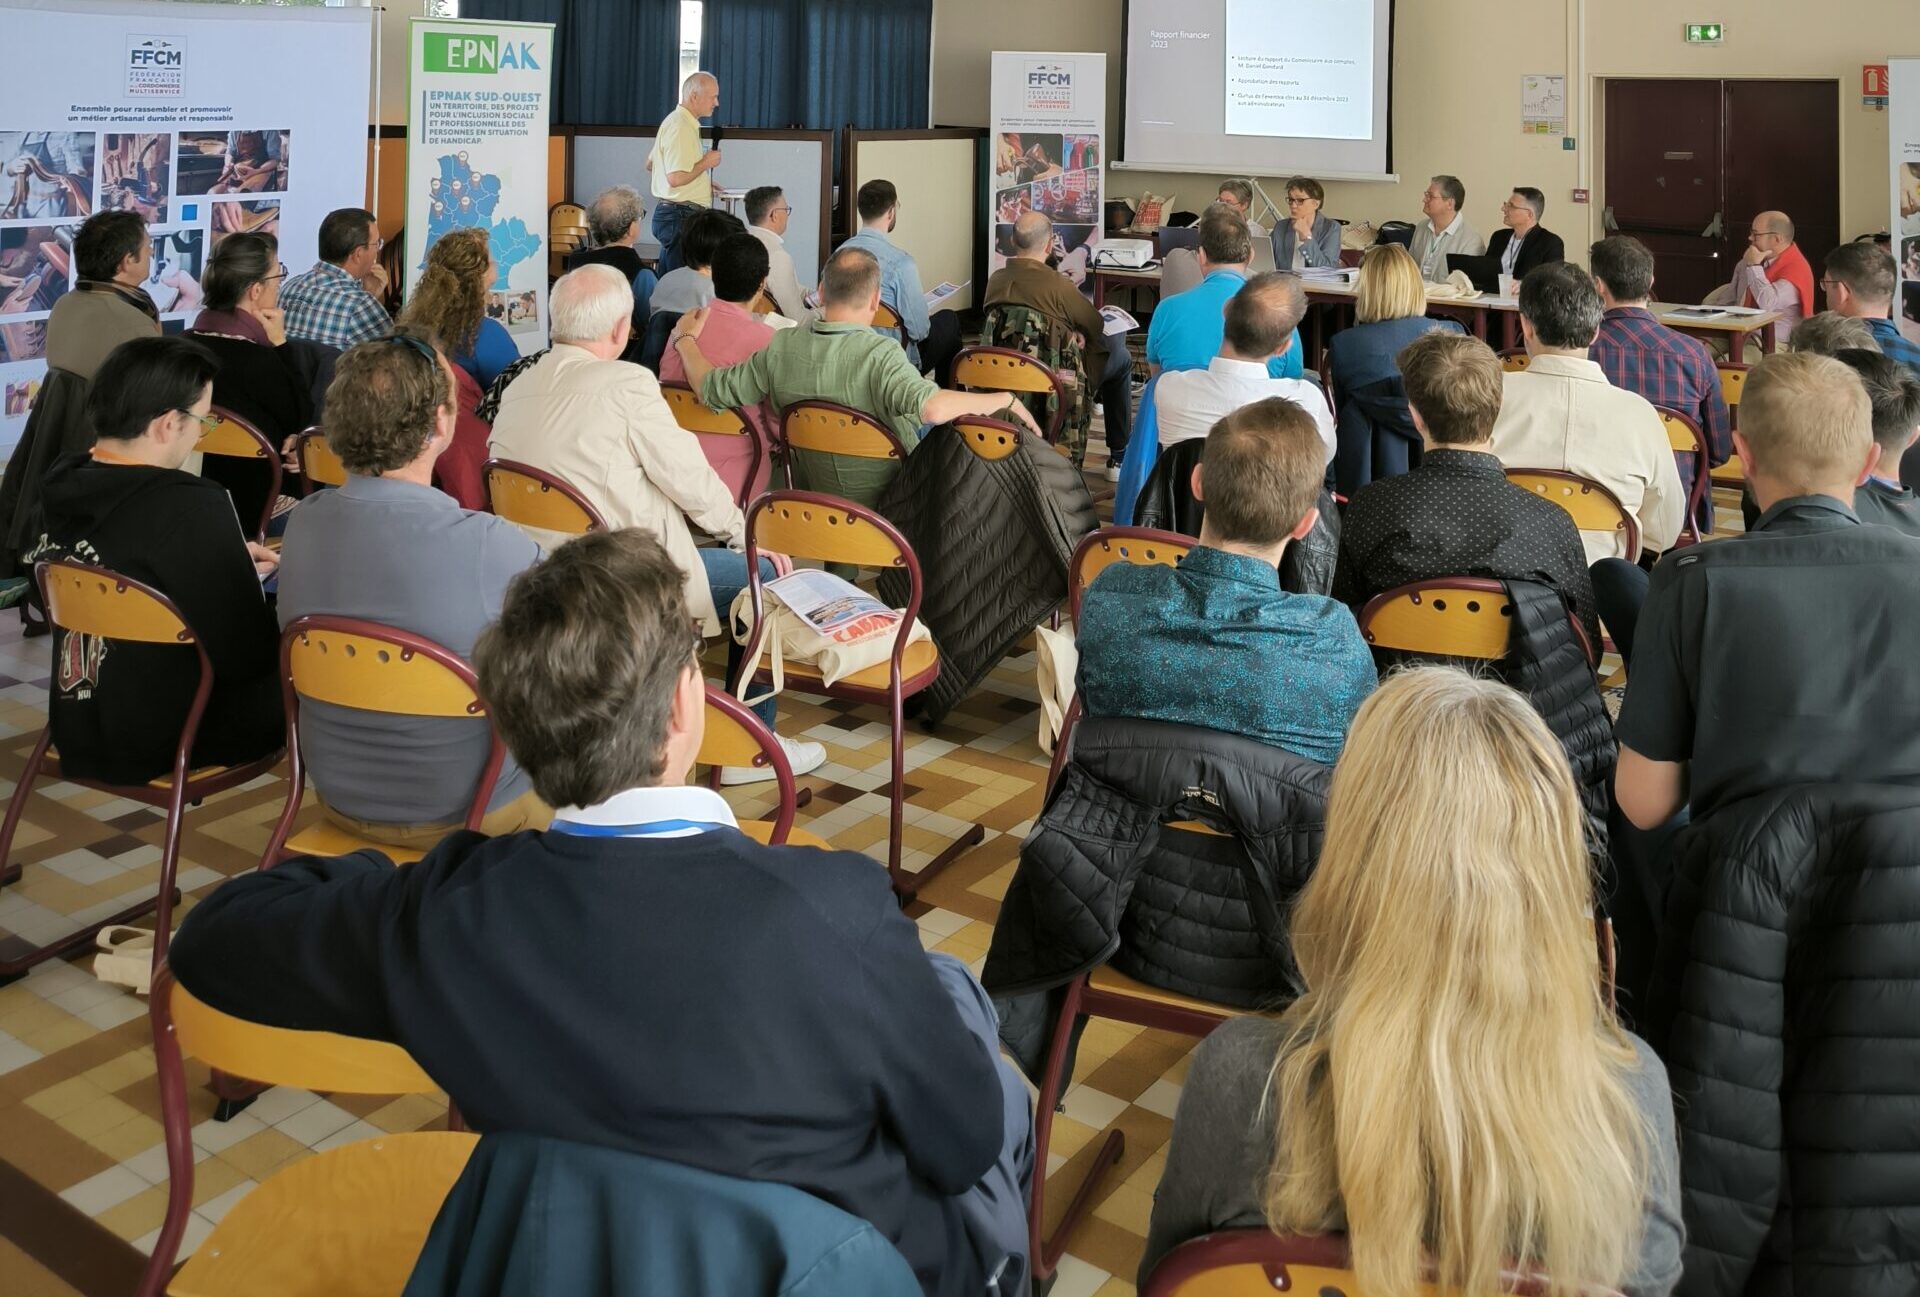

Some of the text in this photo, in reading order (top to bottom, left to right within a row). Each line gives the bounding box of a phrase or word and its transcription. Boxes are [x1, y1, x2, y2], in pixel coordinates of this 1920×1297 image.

[1150, 30, 1210, 40] Rapport financier
[1150, 40, 1168, 48] 2023
[131, 50, 181, 65] FFCM
[447, 38, 541, 70] EPNAK
[1028, 73, 1071, 85] FFCM
[430, 91, 542, 103] EPNAK SUD-OUEST
[71, 105, 111, 113] Ensemble
[113, 106, 132, 114] pour
[134, 105, 178, 113] rassembler
[189, 106, 233, 114] promouvoir
[188, 115, 234, 123] responsable
